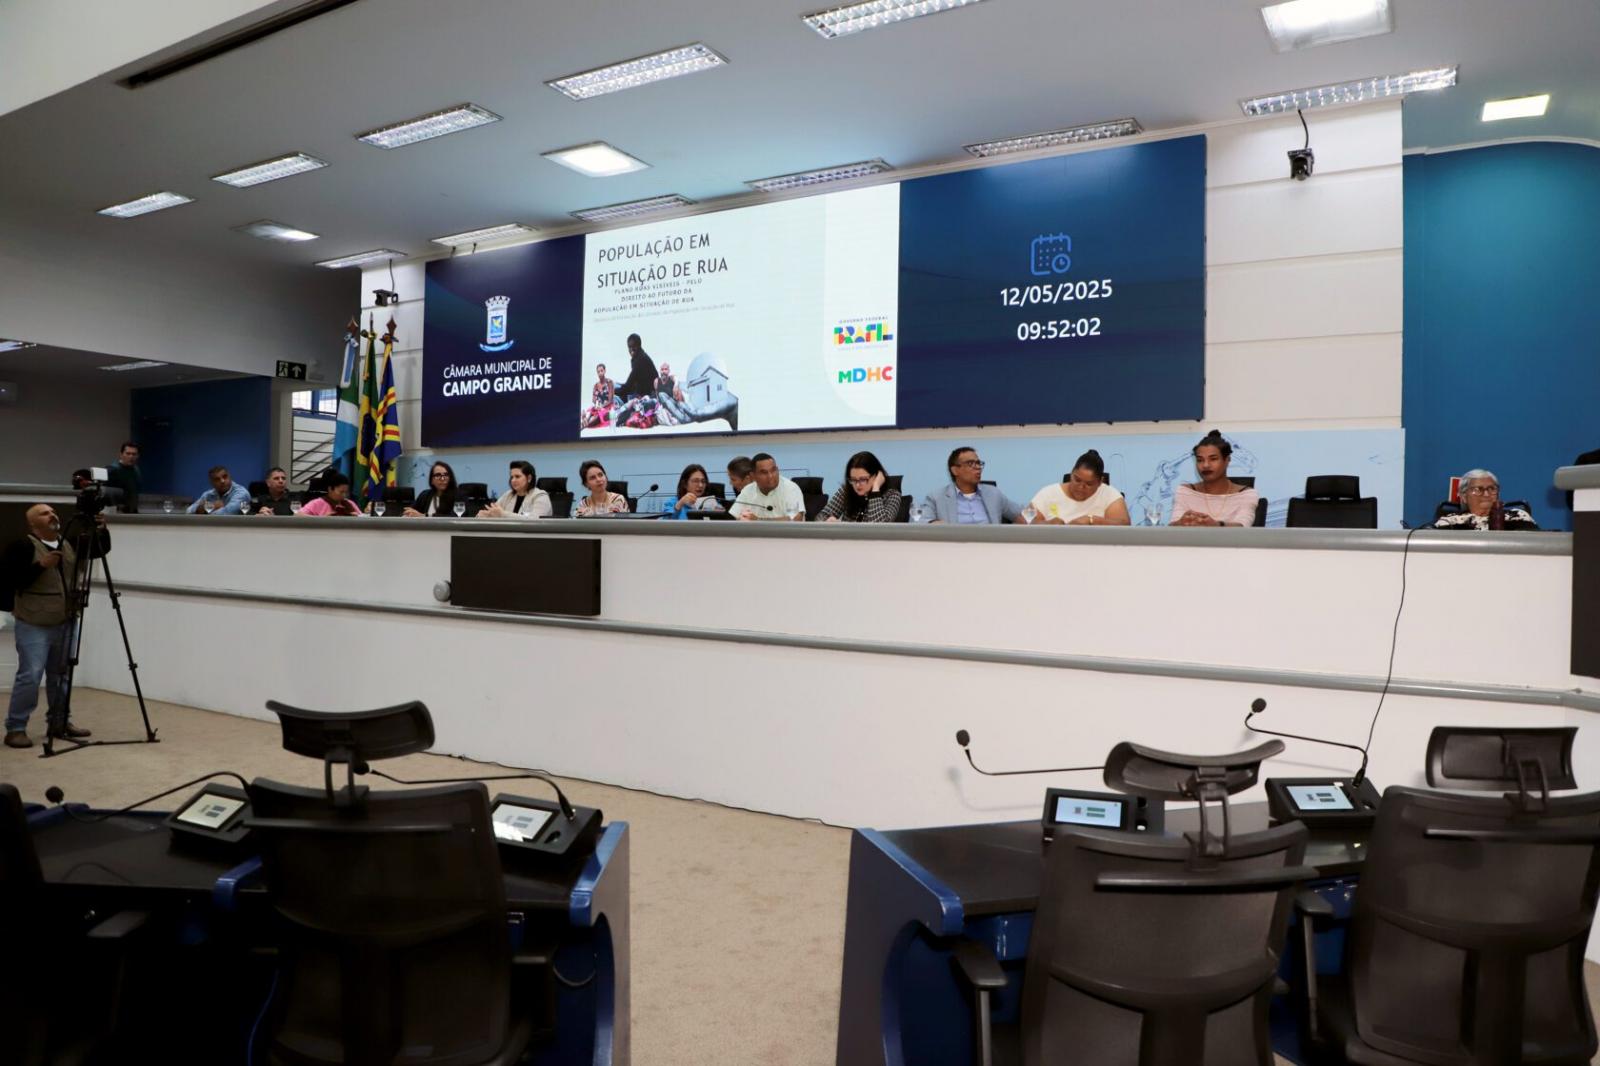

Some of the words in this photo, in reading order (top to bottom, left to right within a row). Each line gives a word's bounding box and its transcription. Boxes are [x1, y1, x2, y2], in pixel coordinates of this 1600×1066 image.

[599, 235, 683, 263] POPULAÇÃO
[689, 233, 710, 248] EM
[597, 264, 667, 288] SITUAÇÃO
[673, 262, 691, 277] DE
[698, 257, 728, 274] RUA
[621, 293, 646, 302] DIREITO
[657, 289, 681, 297] FUTURO
[1000, 279, 1113, 307] 12/05/2025
[1017, 317, 1101, 341] 09:52:02
[443, 364, 482, 379] CÂMARA
[484, 359, 536, 375] MUNICIPAL
[539, 357, 552, 370] DE
[838, 366, 893, 384] MDHC
[442, 379, 490, 397] CAMPO
[493, 373, 552, 393] GRANDE
